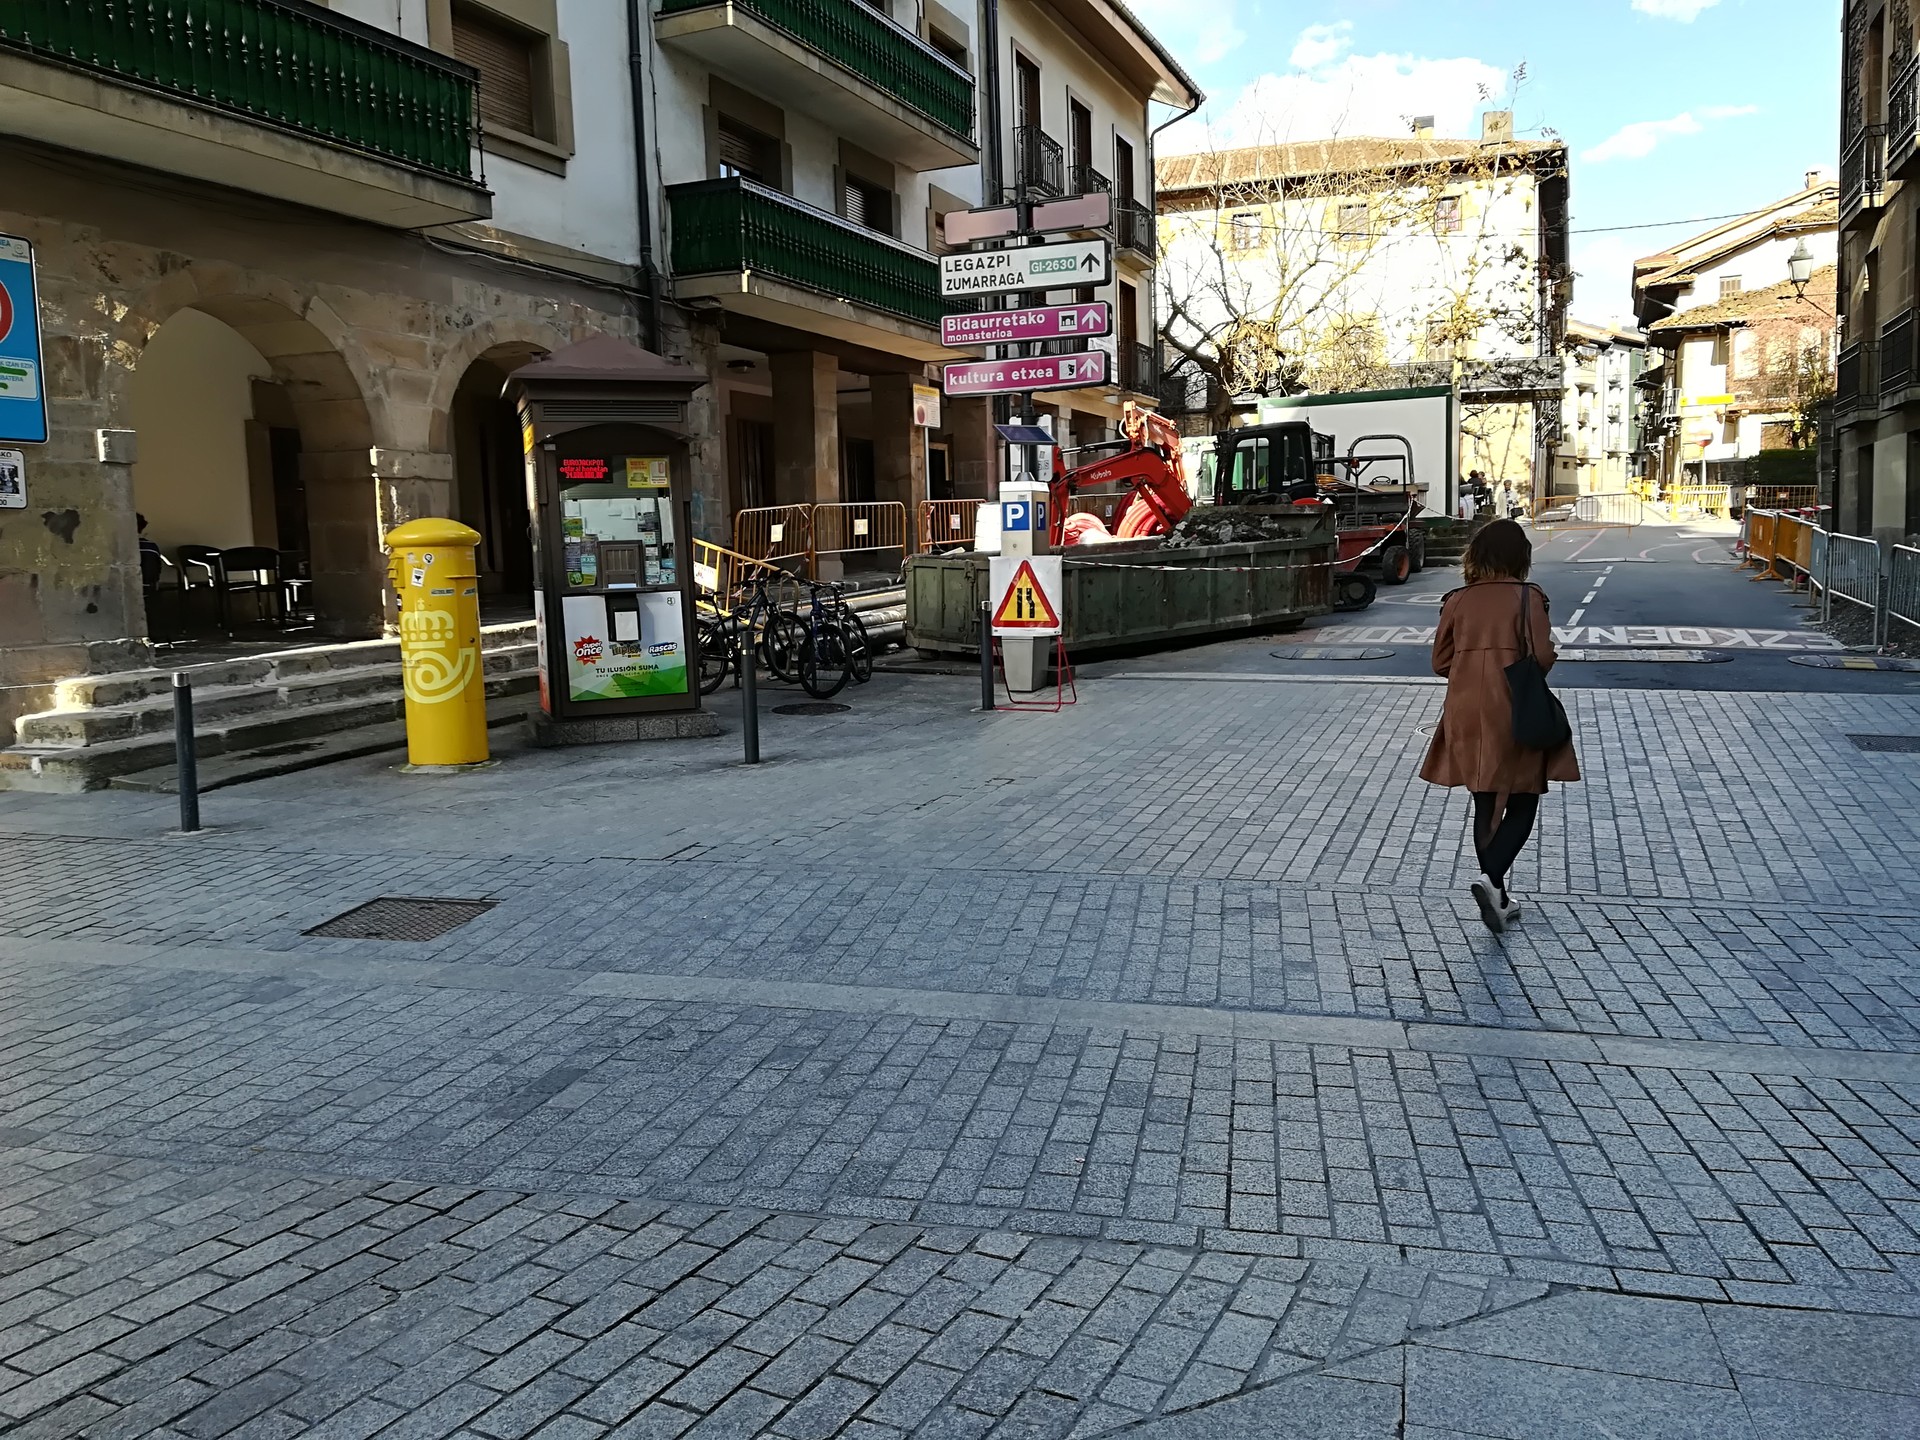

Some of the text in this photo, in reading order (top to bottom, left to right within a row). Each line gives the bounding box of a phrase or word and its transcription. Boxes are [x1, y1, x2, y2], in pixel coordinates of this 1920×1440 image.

[945, 255, 1075, 274] LEGAZPI GI-2630
[946, 272, 1025, 291] ZUMARRAGA
[947, 312, 1045, 332] Bidaurretako
[947, 330, 1013, 342] monasterioa
[950, 367, 1053, 386] kultura etxea
[1006, 503, 1025, 528] P
[1037, 503, 1045, 528] P
[576, 646, 602, 657] Once
[649, 643, 677, 654] Rascas
